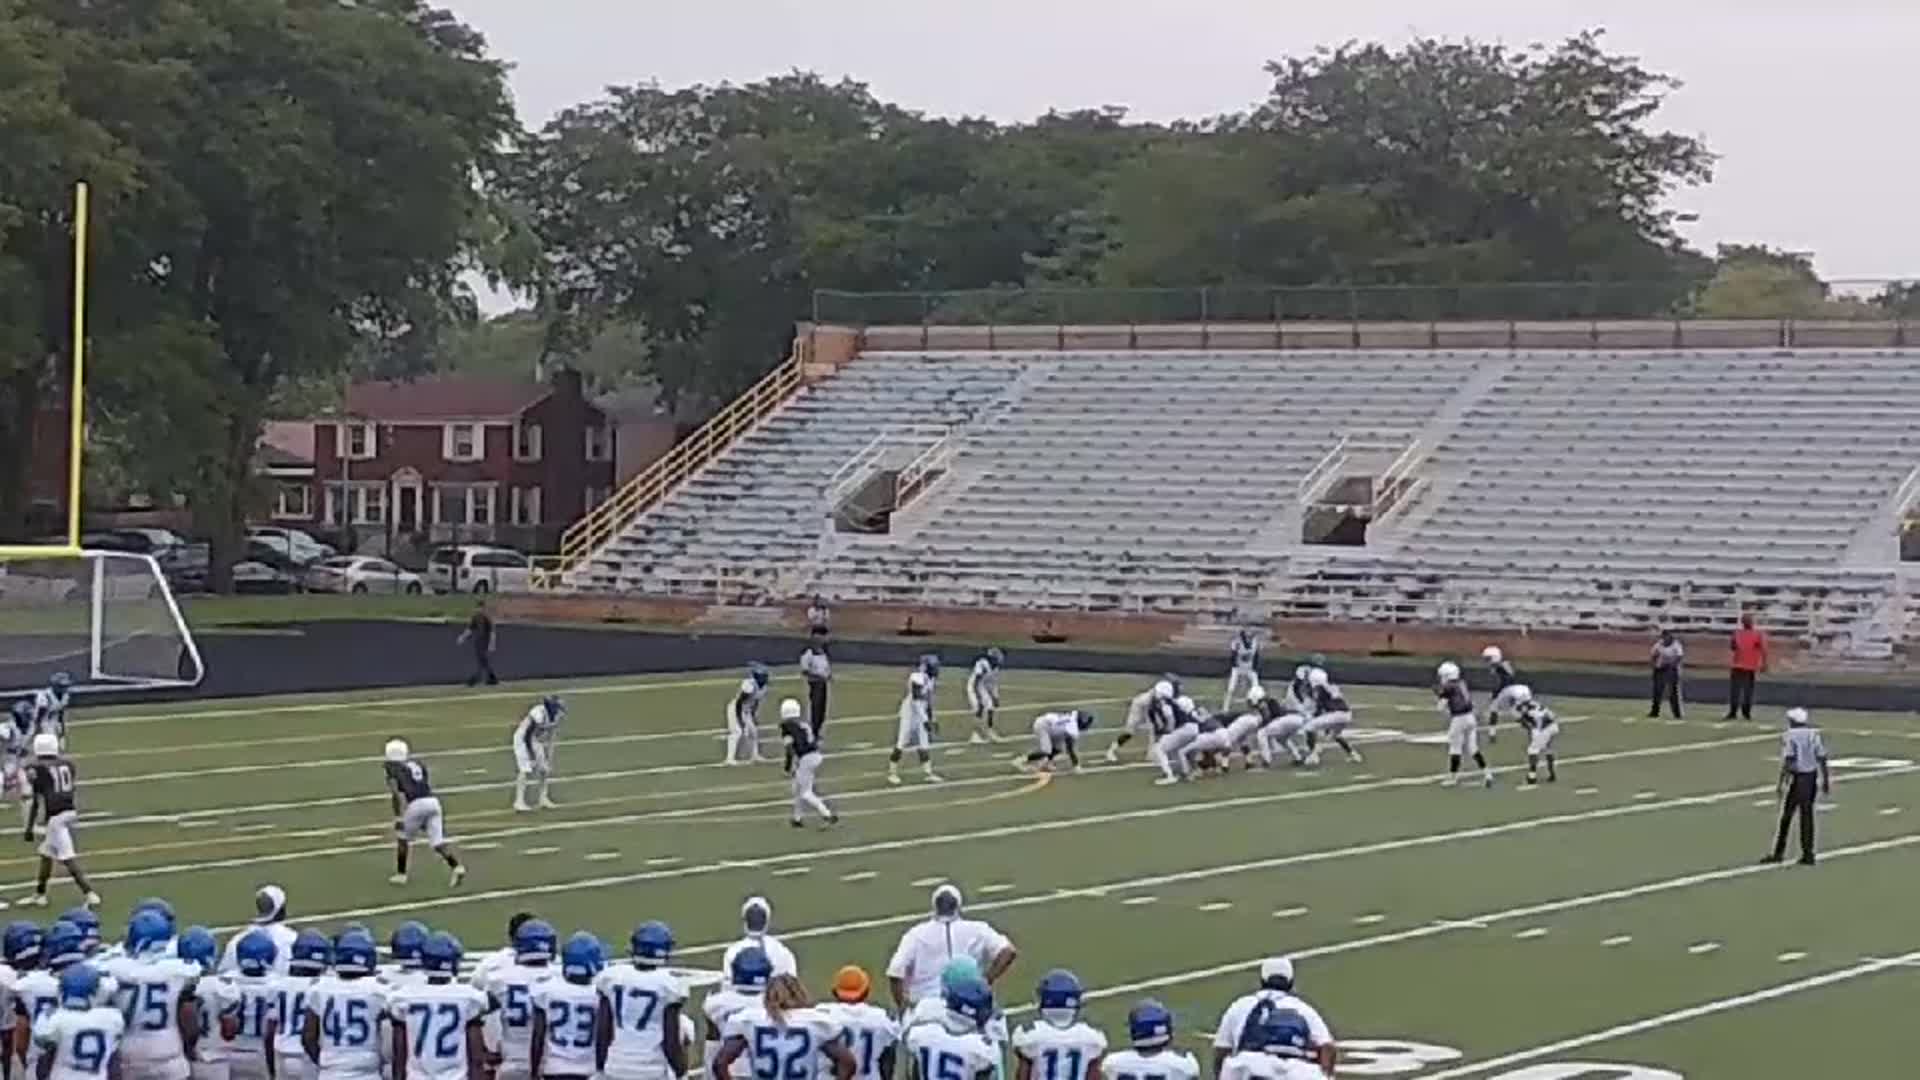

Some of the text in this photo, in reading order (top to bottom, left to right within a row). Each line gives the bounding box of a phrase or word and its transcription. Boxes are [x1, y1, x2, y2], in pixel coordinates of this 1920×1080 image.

[49, 765, 73, 793] 10
[119, 982, 169, 1030] 75
[323, 997, 368, 1047] 45
[548, 1001, 595, 1047] 23
[613, 984, 658, 1030] 17
[70, 1028, 107, 1072] 9
[408, 1003, 460, 1058] 72
[755, 1026, 810, 1078] 52
